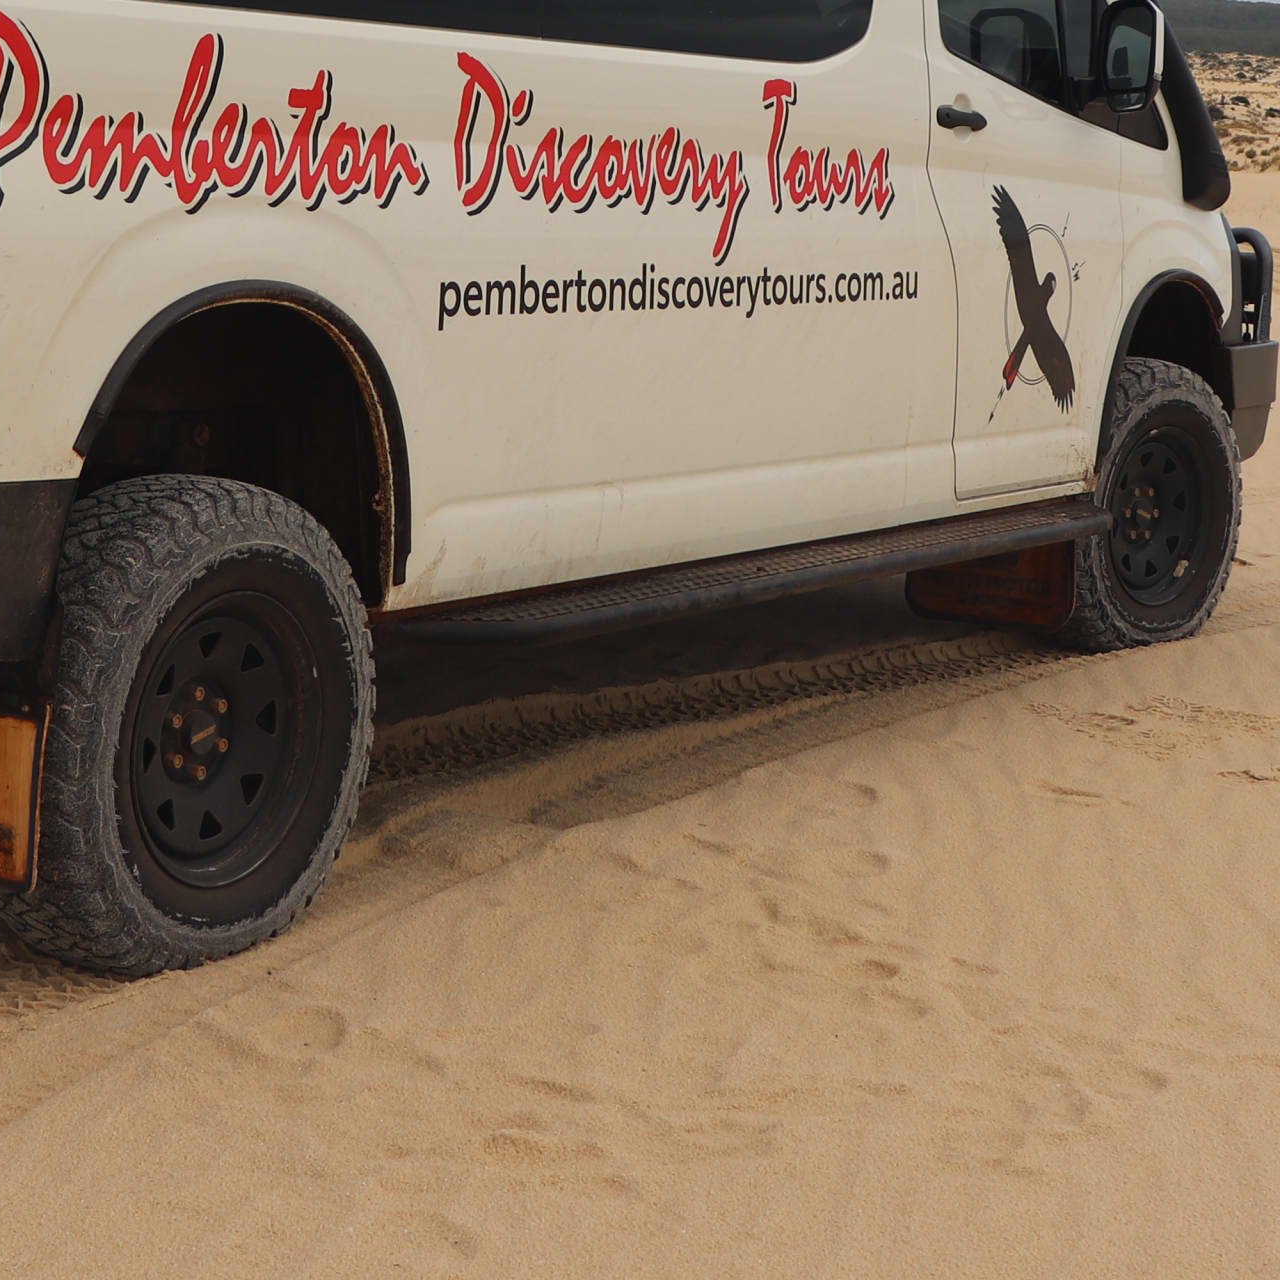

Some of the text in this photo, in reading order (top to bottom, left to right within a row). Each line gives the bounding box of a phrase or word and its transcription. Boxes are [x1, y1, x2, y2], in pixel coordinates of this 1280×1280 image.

[454, 52, 749, 266] Discovery
[763, 79, 894, 220] Tours
[438, 263, 919, 331] pembertondiscoverytours.com.au
